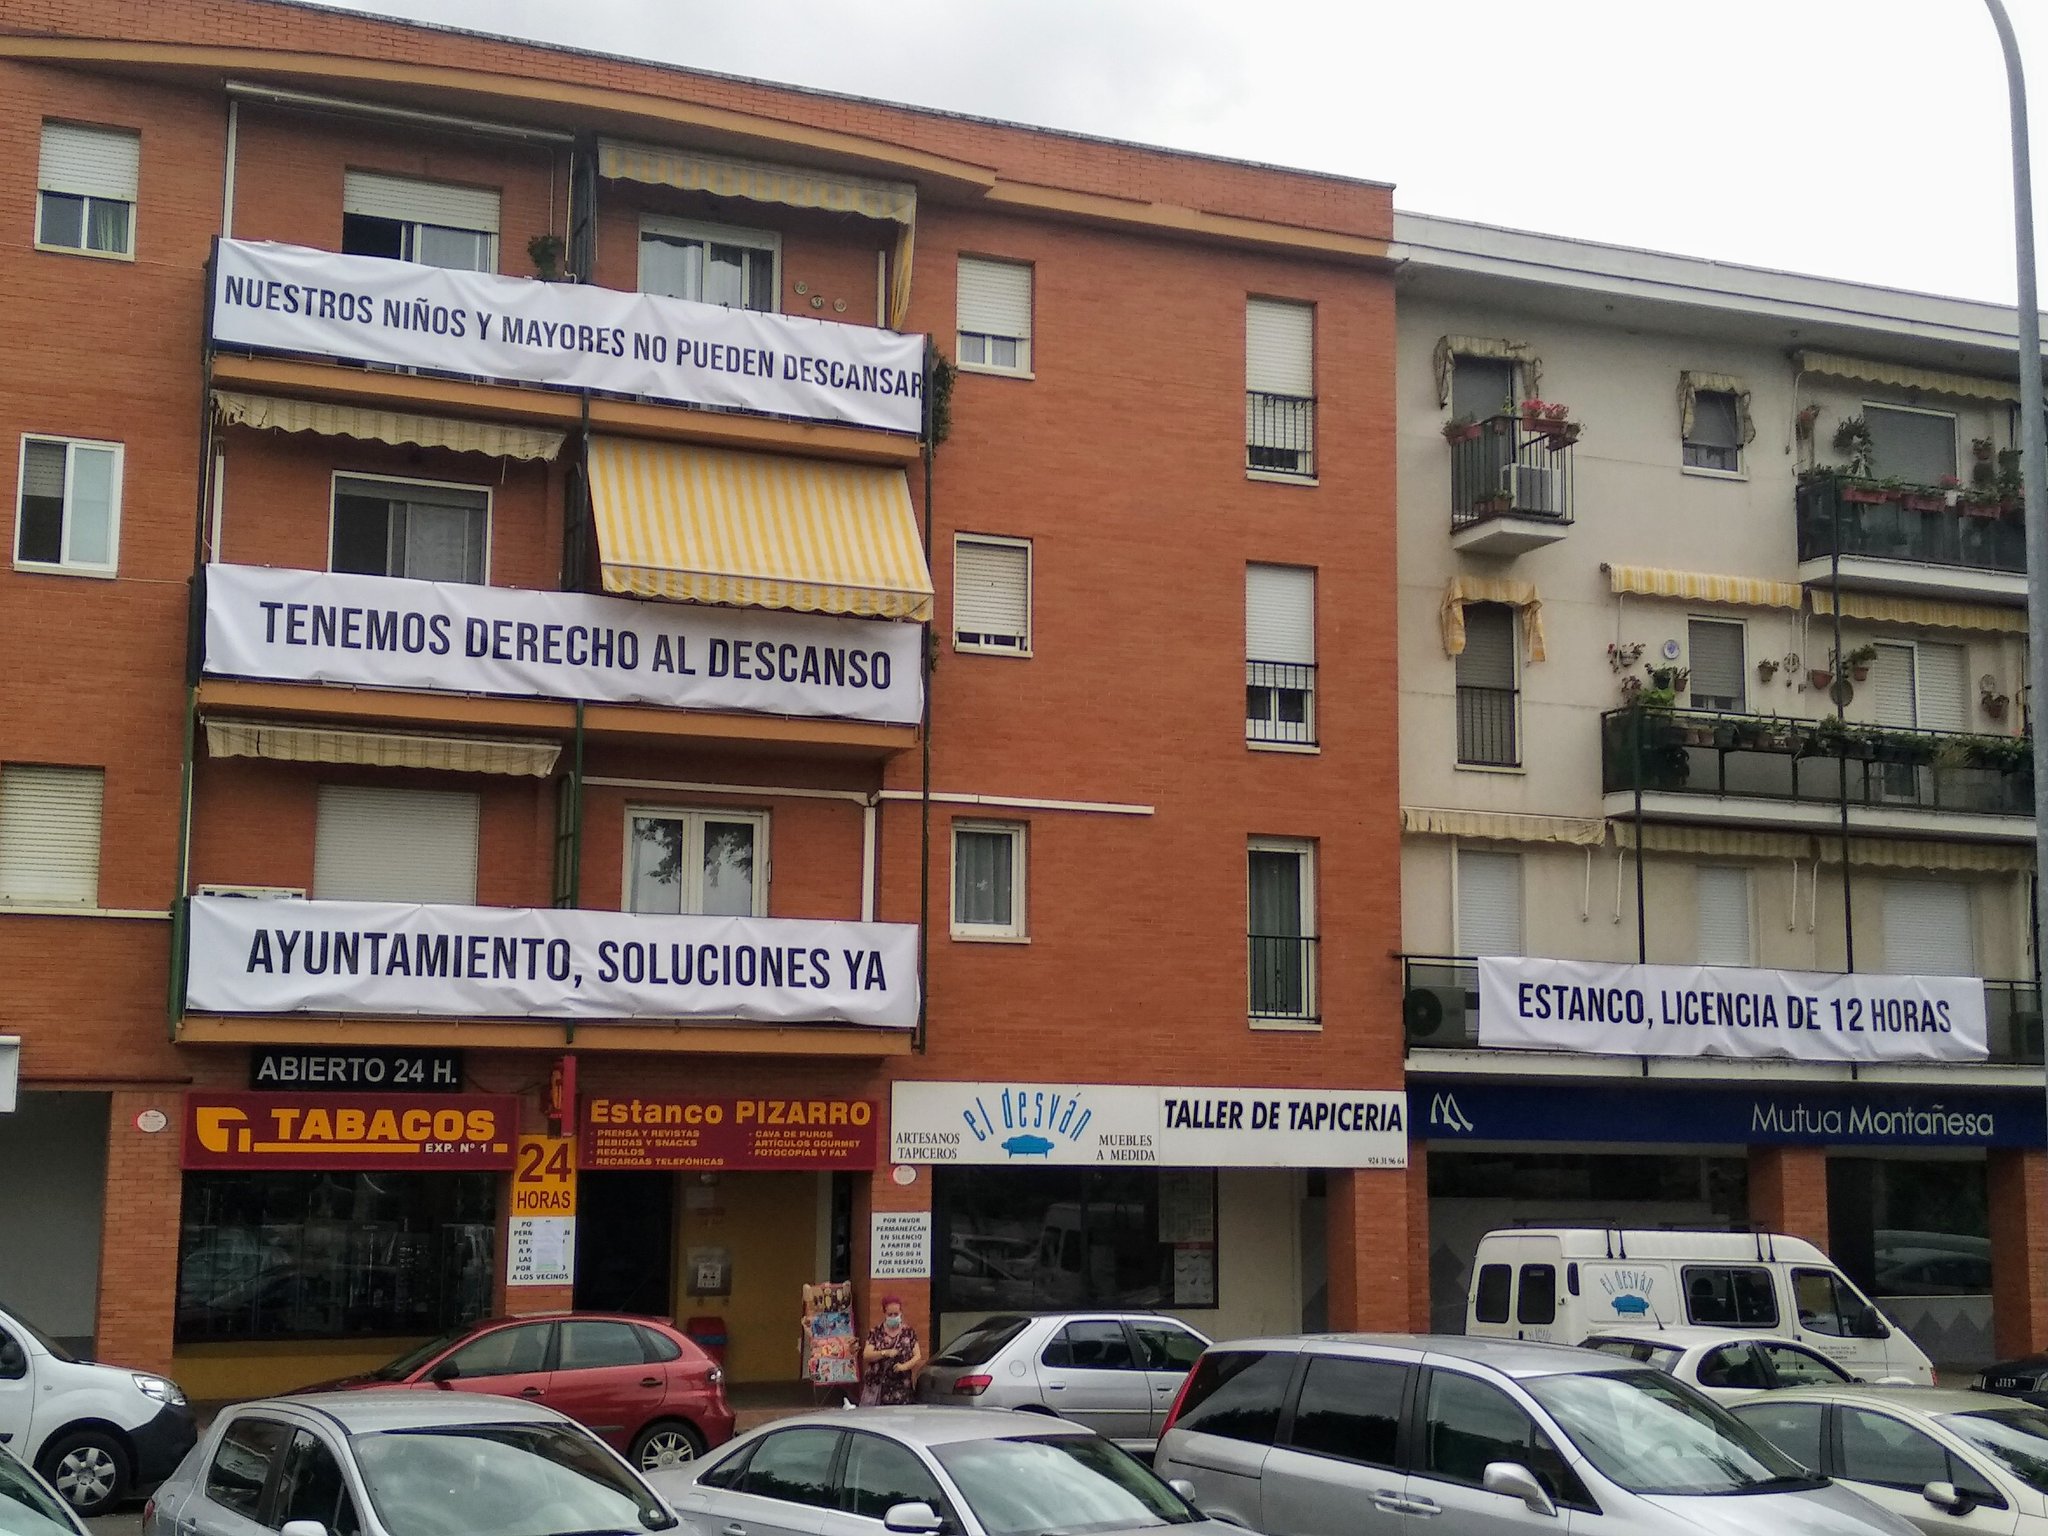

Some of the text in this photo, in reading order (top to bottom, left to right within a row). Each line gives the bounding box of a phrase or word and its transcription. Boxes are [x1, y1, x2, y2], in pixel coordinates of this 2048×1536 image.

[224, 274, 923, 400] NUESTROS NIÑOS Y MAYORES NO PUEDEN DESCANSAR
[259, 601, 891, 690] TENEMOS DERECHO AL DESCANSO
[246, 929, 887, 991] AYUNTAMIENTO, SOLUCIONES YA
[1518, 982, 1952, 1033] ESTANCO, LICENCIA DE 12 HORAS
[257, 1056, 457, 1083] ABIERTO 24 H.
[590, 1099, 871, 1125] Estanco PIZARRO
[963, 1087, 1092, 1142] el desván
[1165, 1100, 1403, 1132] TALLER DE TAPICERIA
[1751, 1103, 1994, 1136] Mutua Montañesa
[271, 1108, 495, 1141] TABACOS
[597, 1129, 639, 1137] PRENSA
[755, 1130, 781, 1138] CAVA
[895, 1132, 960, 1145] ARTESANOS
[1098, 1134, 1152, 1146] MUEBLES
[425, 1143, 454, 1153] EXP.
[480, 1144, 487, 1153] 1
[596, 1139, 642, 1147] BEBIDAS
[655, 1139, 697, 1147] SNACKS
[754, 1138, 860, 1148] ARTÍCULOS GOURMET
[596, 1148, 645, 1156] REGALOS
[754, 1149, 817, 1157] FOTOCOPIAS
[897, 1147, 957, 1160] TAPICEROS
[1096, 1149, 1155, 1161] A MEDIDA
[519, 1142, 572, 1183] 24
[595, 1156, 724, 1166] RECARGAS TELEFÓNICAS
[517, 1190, 571, 1209] HORAS
